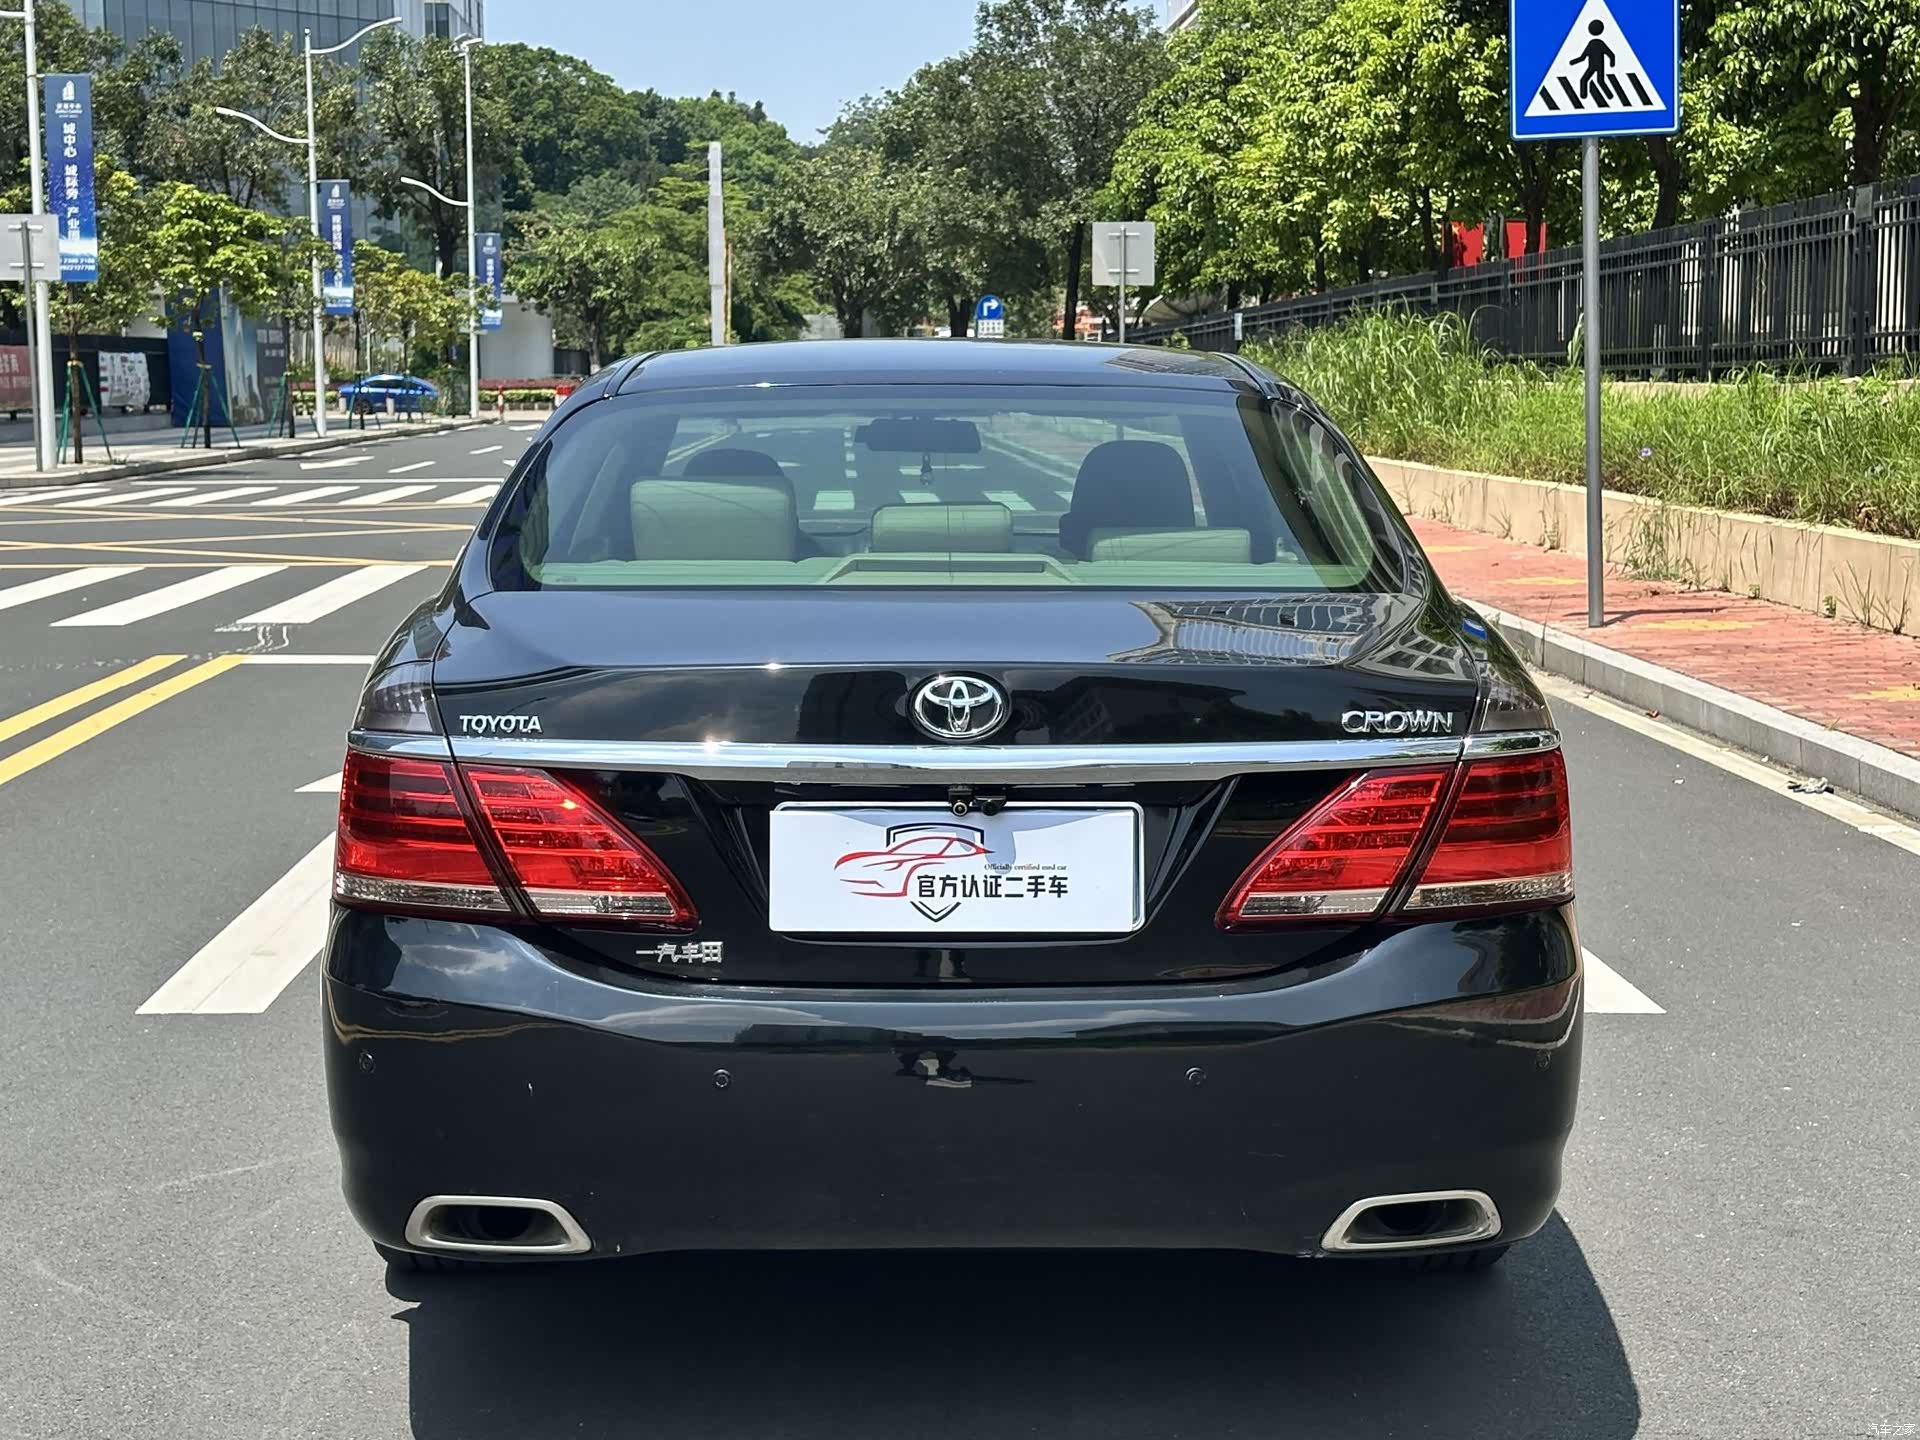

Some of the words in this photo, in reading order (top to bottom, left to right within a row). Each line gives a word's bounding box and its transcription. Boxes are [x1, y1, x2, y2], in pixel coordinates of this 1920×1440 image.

[459, 714, 542, 734] TOYOTA
[1341, 709, 1453, 734] CROWN
[984, 863, 1012, 871] Officially
[1014, 863, 1040, 871] certified
[917, 874, 1068, 898] 官方认证二手车
[635, 941, 724, 964] 一汽丰田
